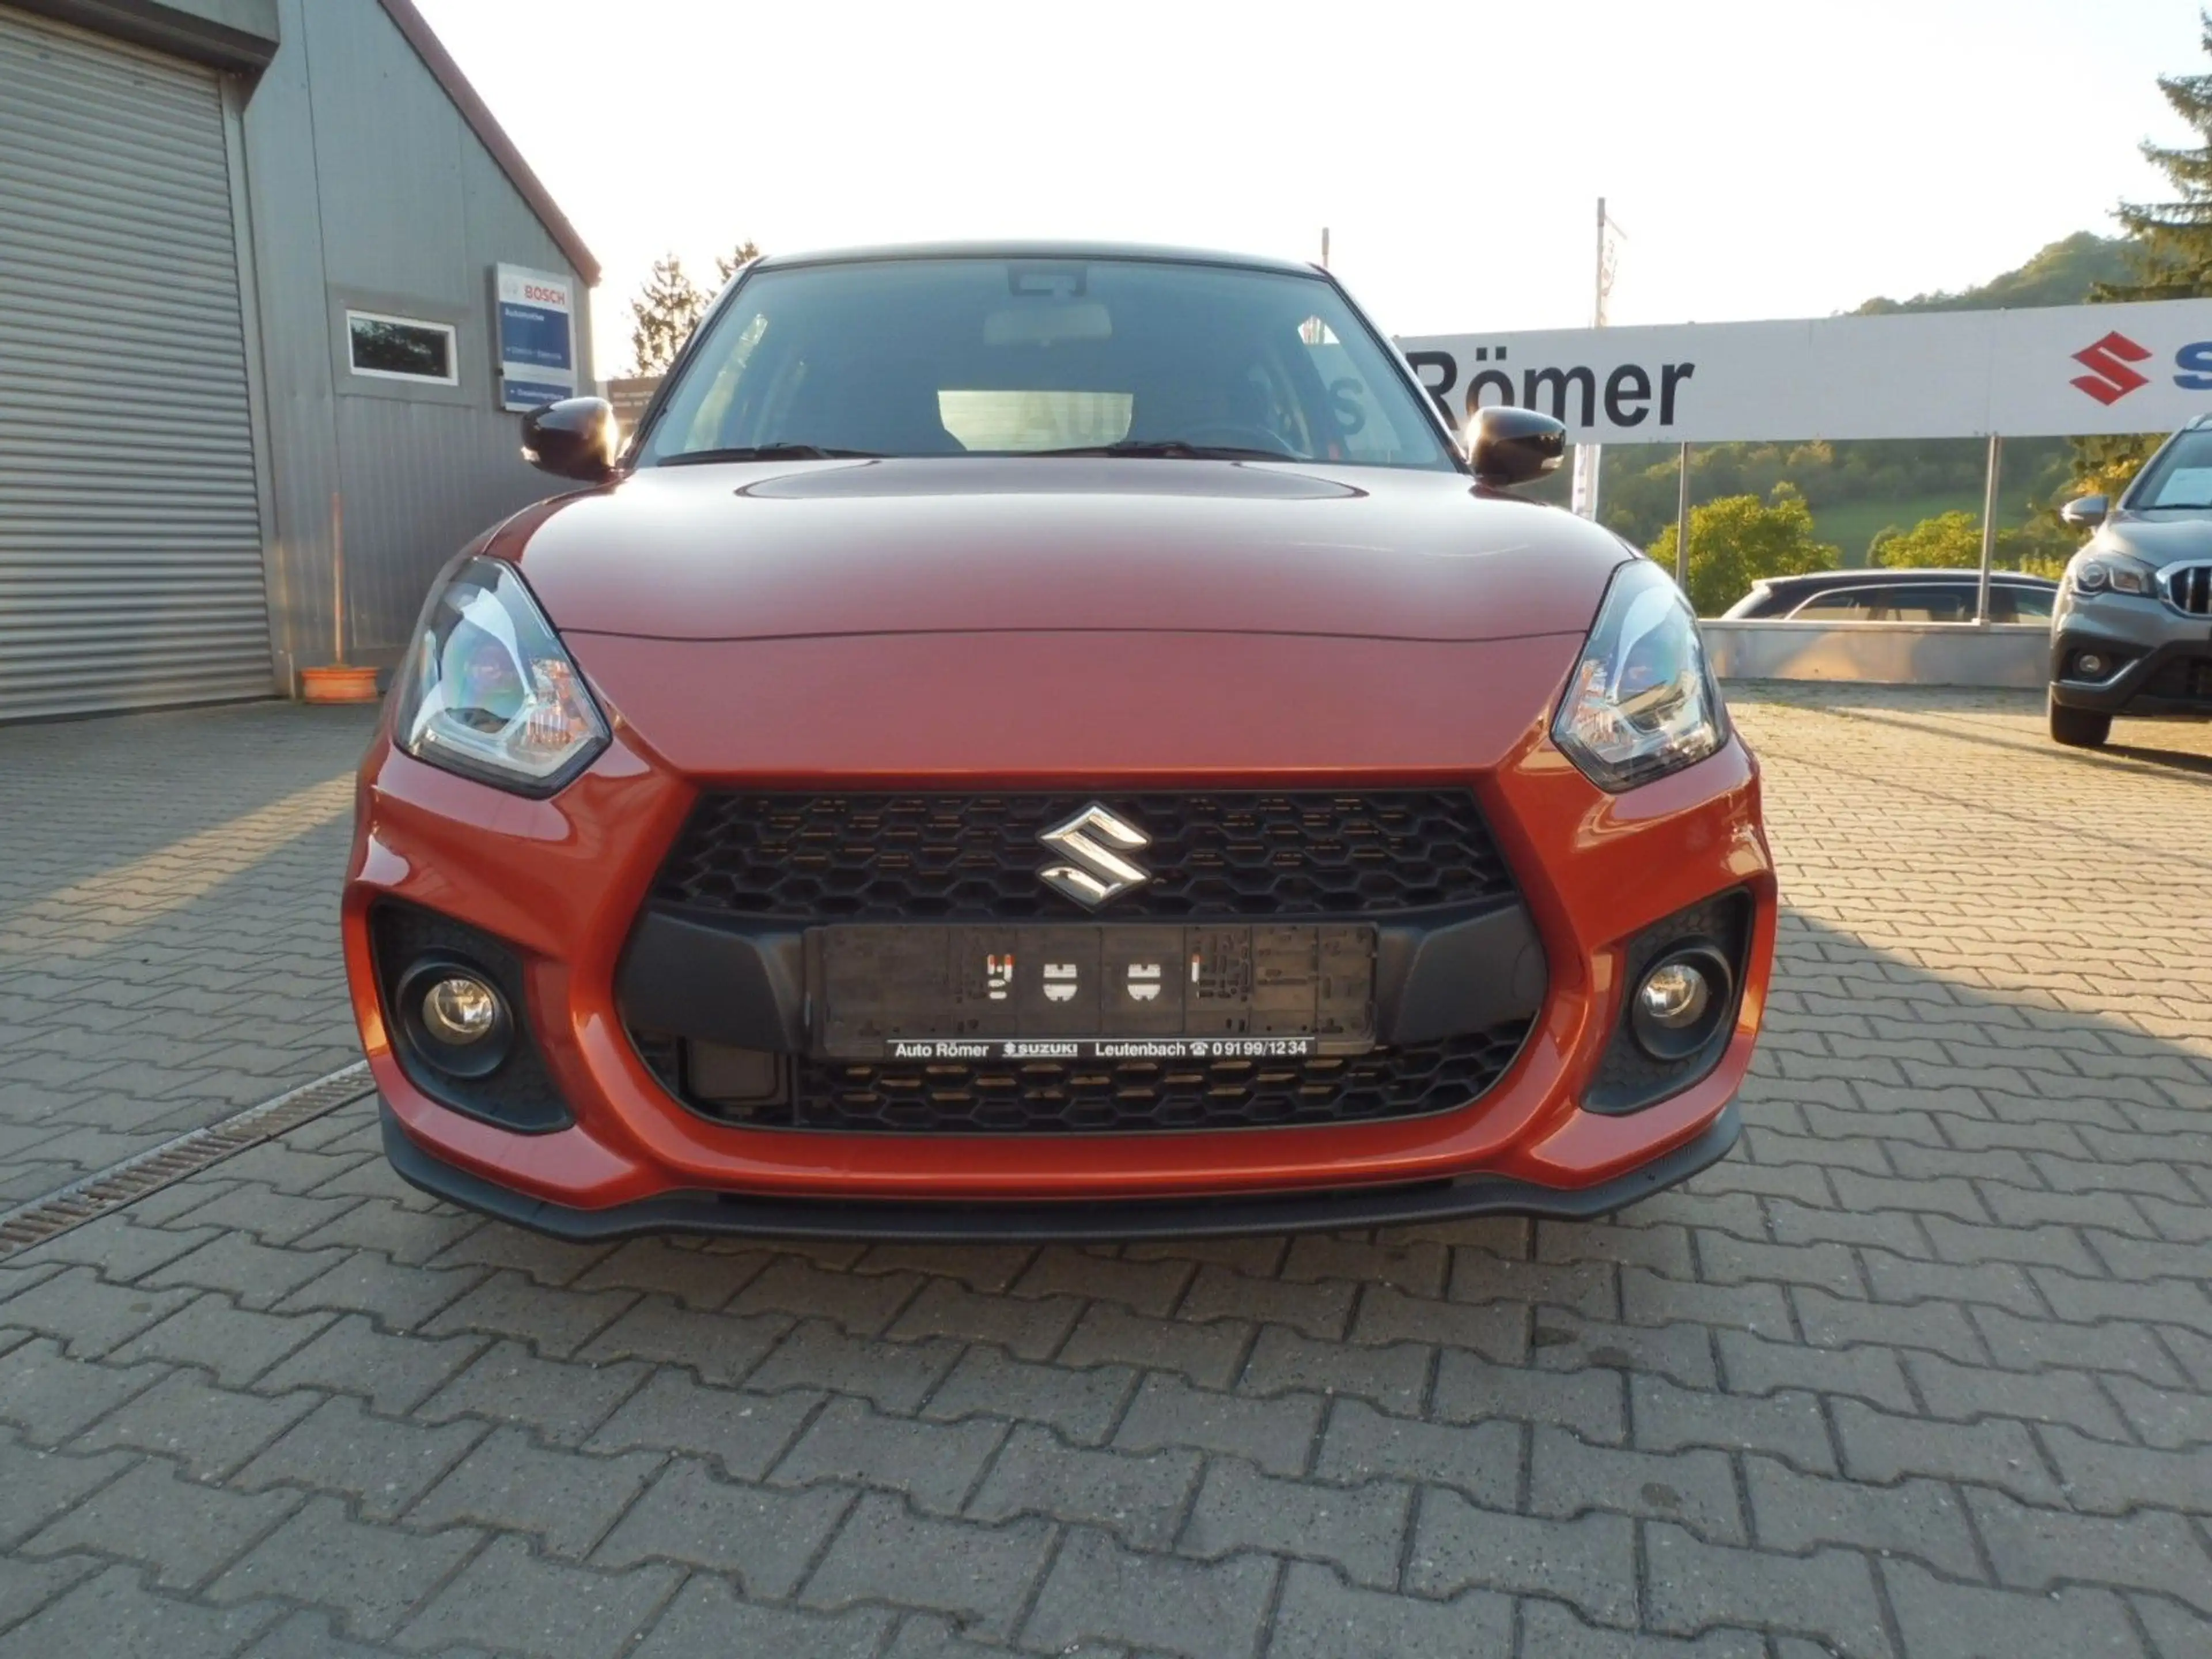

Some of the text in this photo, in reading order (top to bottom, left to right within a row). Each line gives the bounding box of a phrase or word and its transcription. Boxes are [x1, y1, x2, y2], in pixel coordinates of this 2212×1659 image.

[524, 284, 565, 306] BOSCH
[1404, 346, 1695, 430] Römer
[895, 1043, 932, 1056] Auto
[936, 1041, 989, 1056] Römer
[1017, 1043, 1078, 1054] SUZUKI
[1095, 1041, 1186, 1056] Leutenbach
